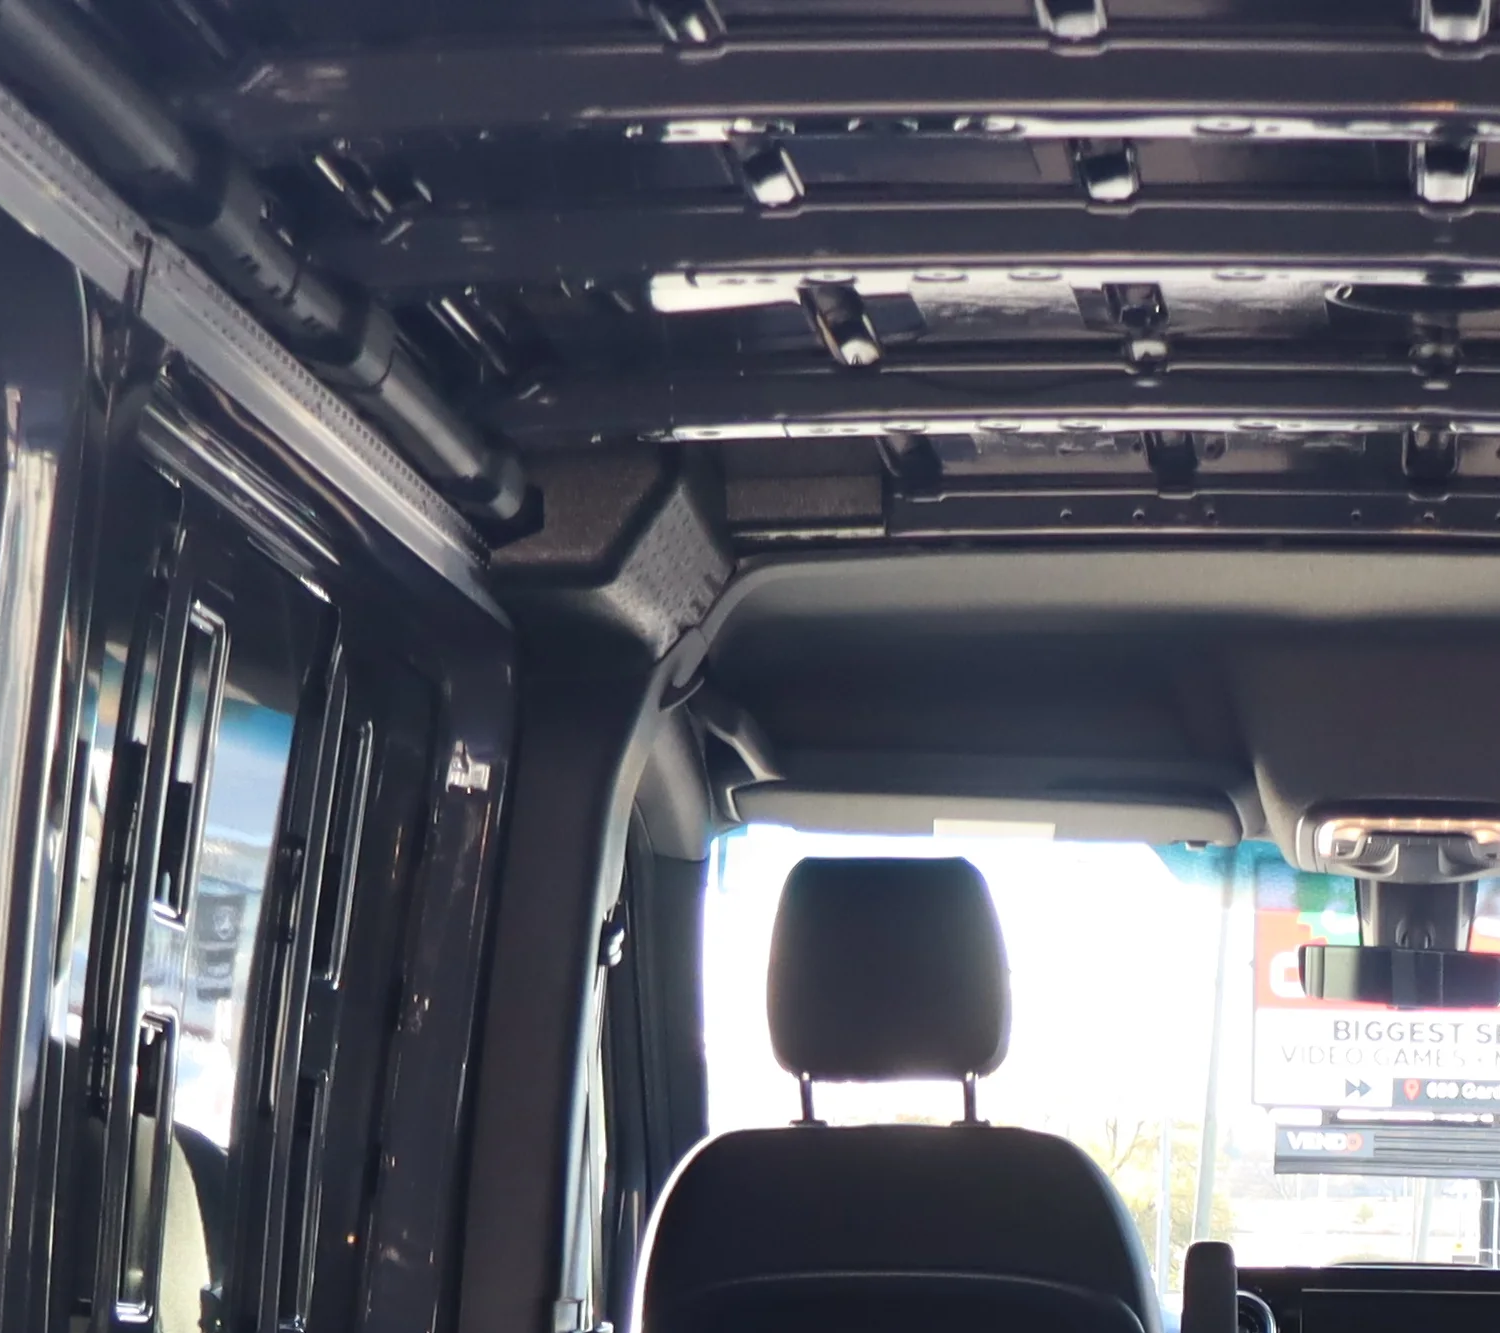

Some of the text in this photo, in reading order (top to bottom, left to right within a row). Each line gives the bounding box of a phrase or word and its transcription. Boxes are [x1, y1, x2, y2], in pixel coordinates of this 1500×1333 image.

[1333, 1019, 1463, 1045] BIGGEST
[1281, 1044, 1363, 1065] VIDEO
[1373, 1047, 1466, 1068] GAMES
